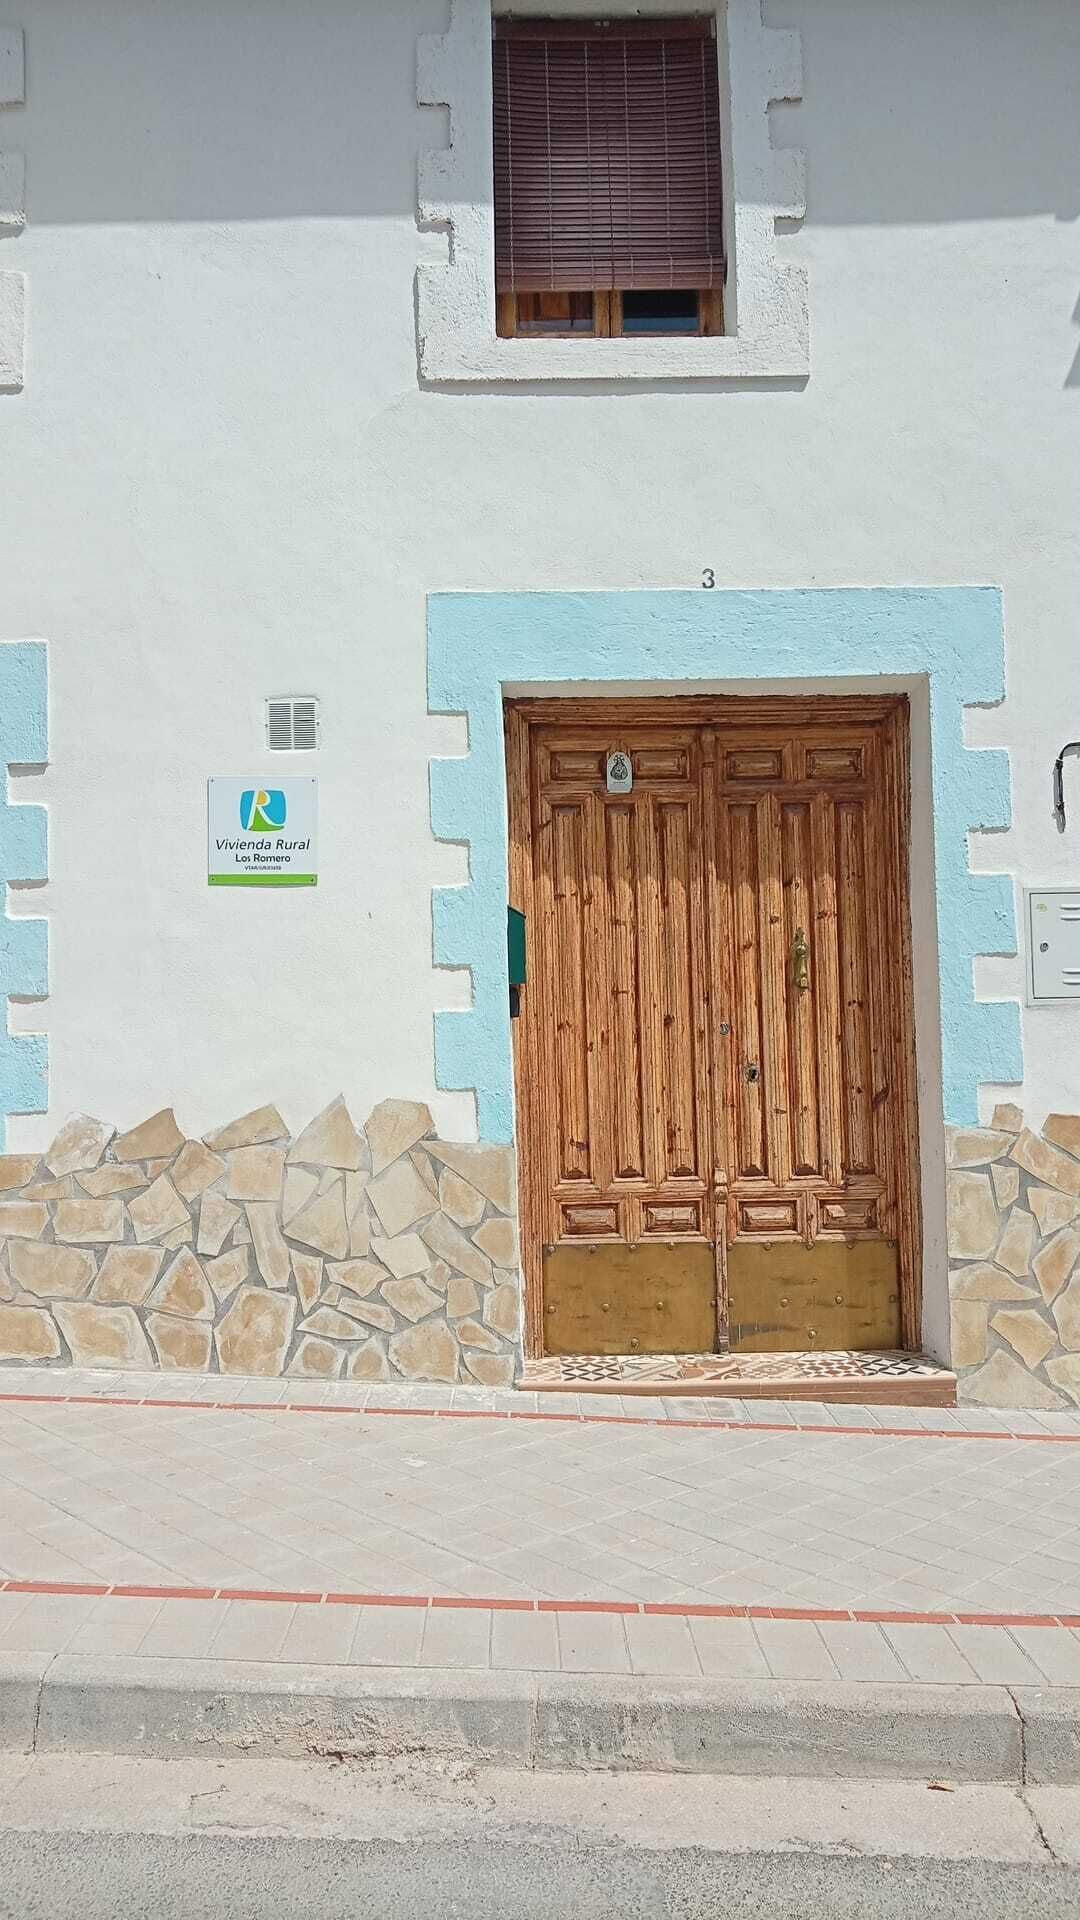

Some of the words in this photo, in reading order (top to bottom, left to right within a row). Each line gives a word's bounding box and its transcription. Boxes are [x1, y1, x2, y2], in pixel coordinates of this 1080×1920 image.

[702, 568, 715, 589] 3
[216, 838, 272, 850] Vivienda
[276, 838, 311, 850] Rural
[235, 853, 251, 863] Los
[253, 853, 291, 863] Romero
